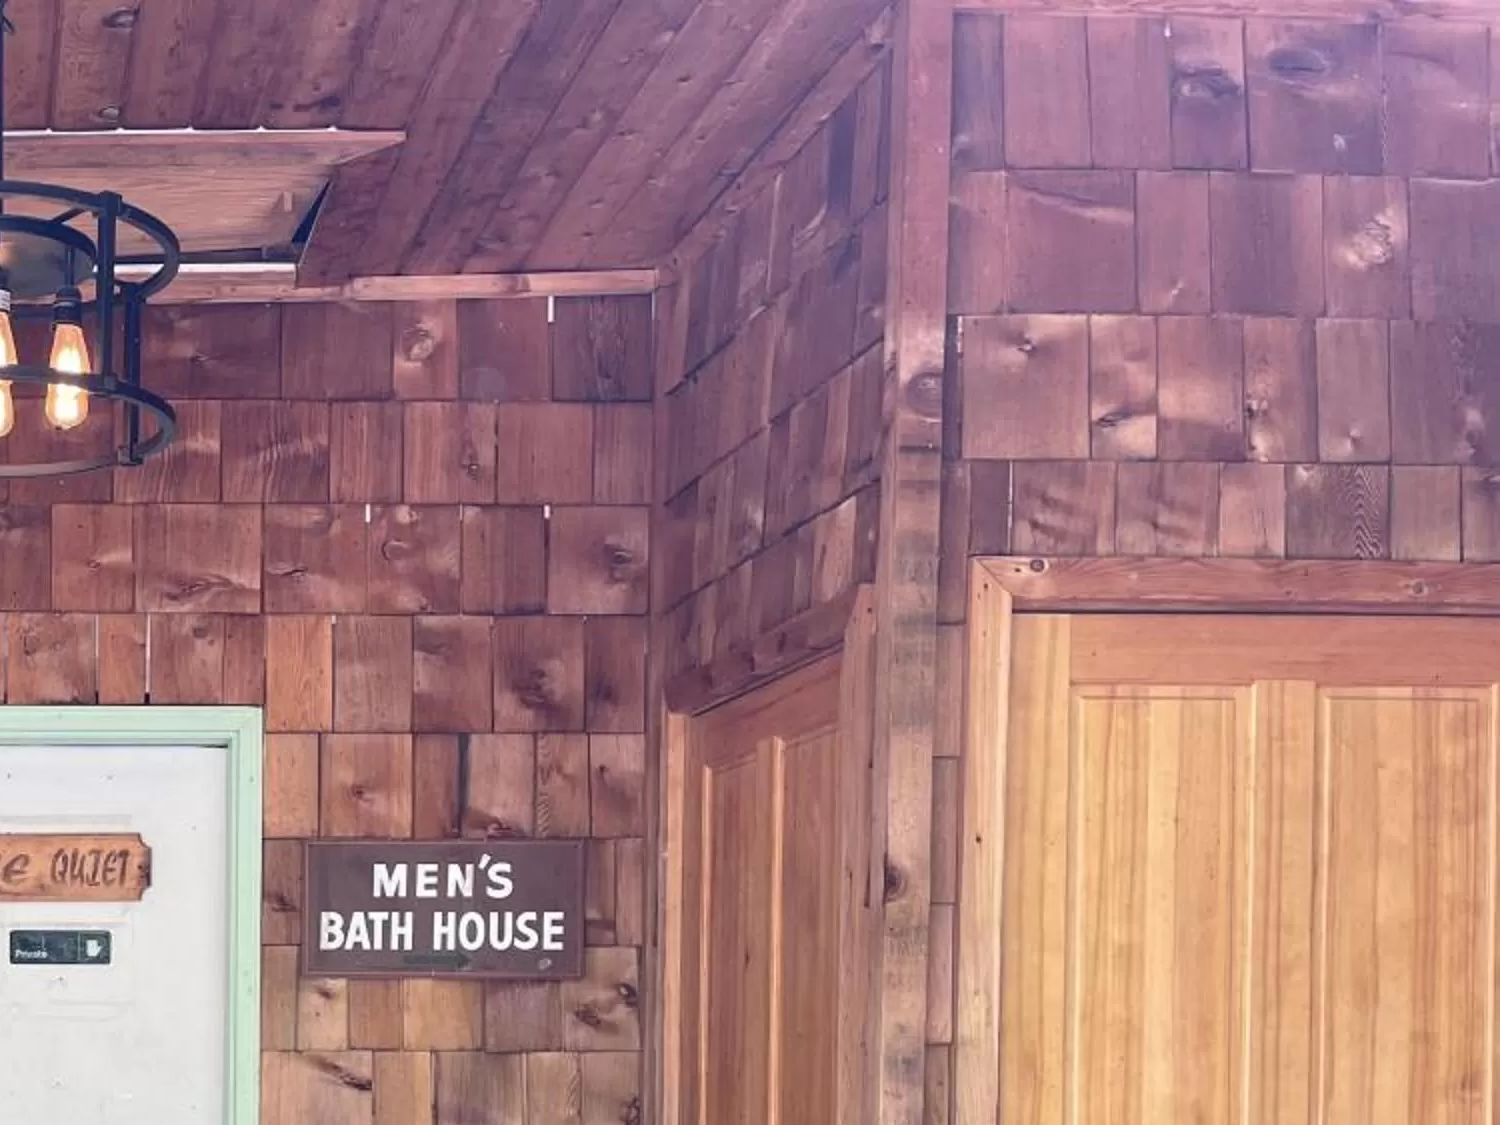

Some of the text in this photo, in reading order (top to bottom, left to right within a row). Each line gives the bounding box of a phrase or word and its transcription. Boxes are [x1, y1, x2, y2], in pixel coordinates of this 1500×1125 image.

[50, 848, 130, 887] QUIET
[372, 853, 513, 899] MEN'S
[319, 911, 565, 951] BATH HOUSE
